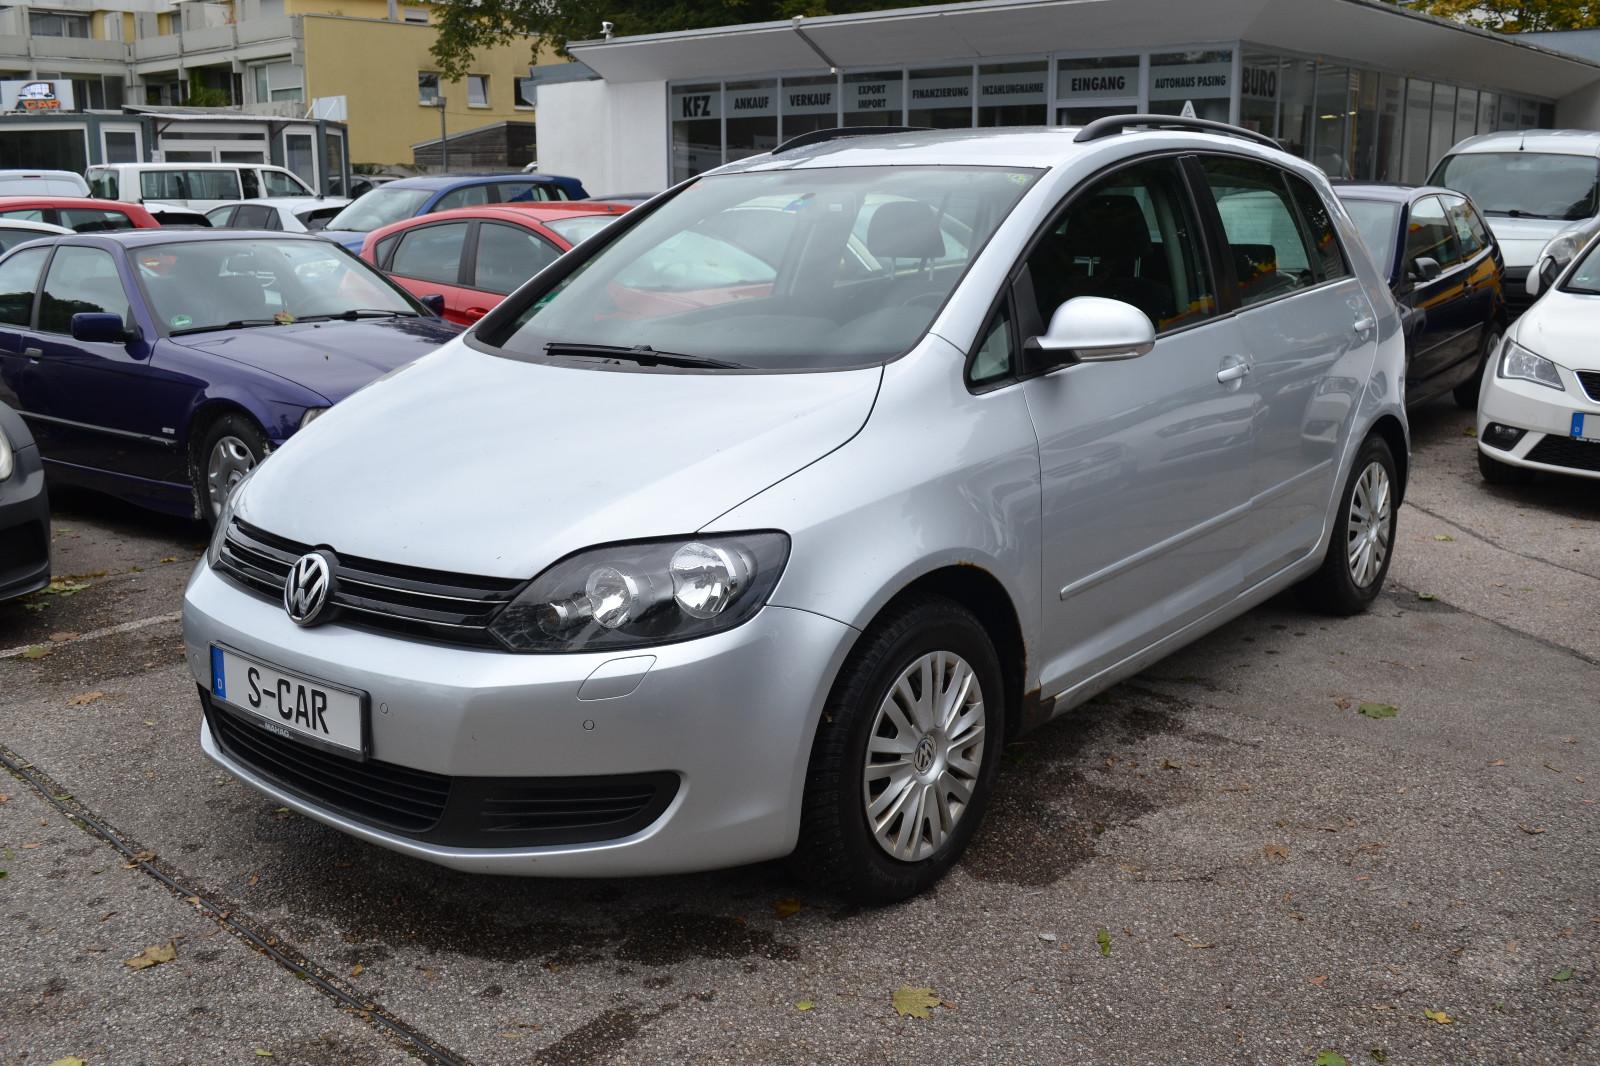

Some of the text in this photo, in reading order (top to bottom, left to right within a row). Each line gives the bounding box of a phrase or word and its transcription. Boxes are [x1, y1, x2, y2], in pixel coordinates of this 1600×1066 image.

[1071, 76, 1125, 92] EINGANG
[1155, 75, 1226, 88] AUTOHAUS PASING
[858, 84, 886, 95] EXPORT
[912, 87, 969, 99] FINANZIERUNG
[682, 95, 711, 118] KFZ
[734, 96, 769, 110] ANKAUF
[790, 93, 831, 107] VERKAUF
[858, 98, 886, 109] IMPORT
[217, 678, 223, 689] D
[247, 666, 329, 734] S-CAR
